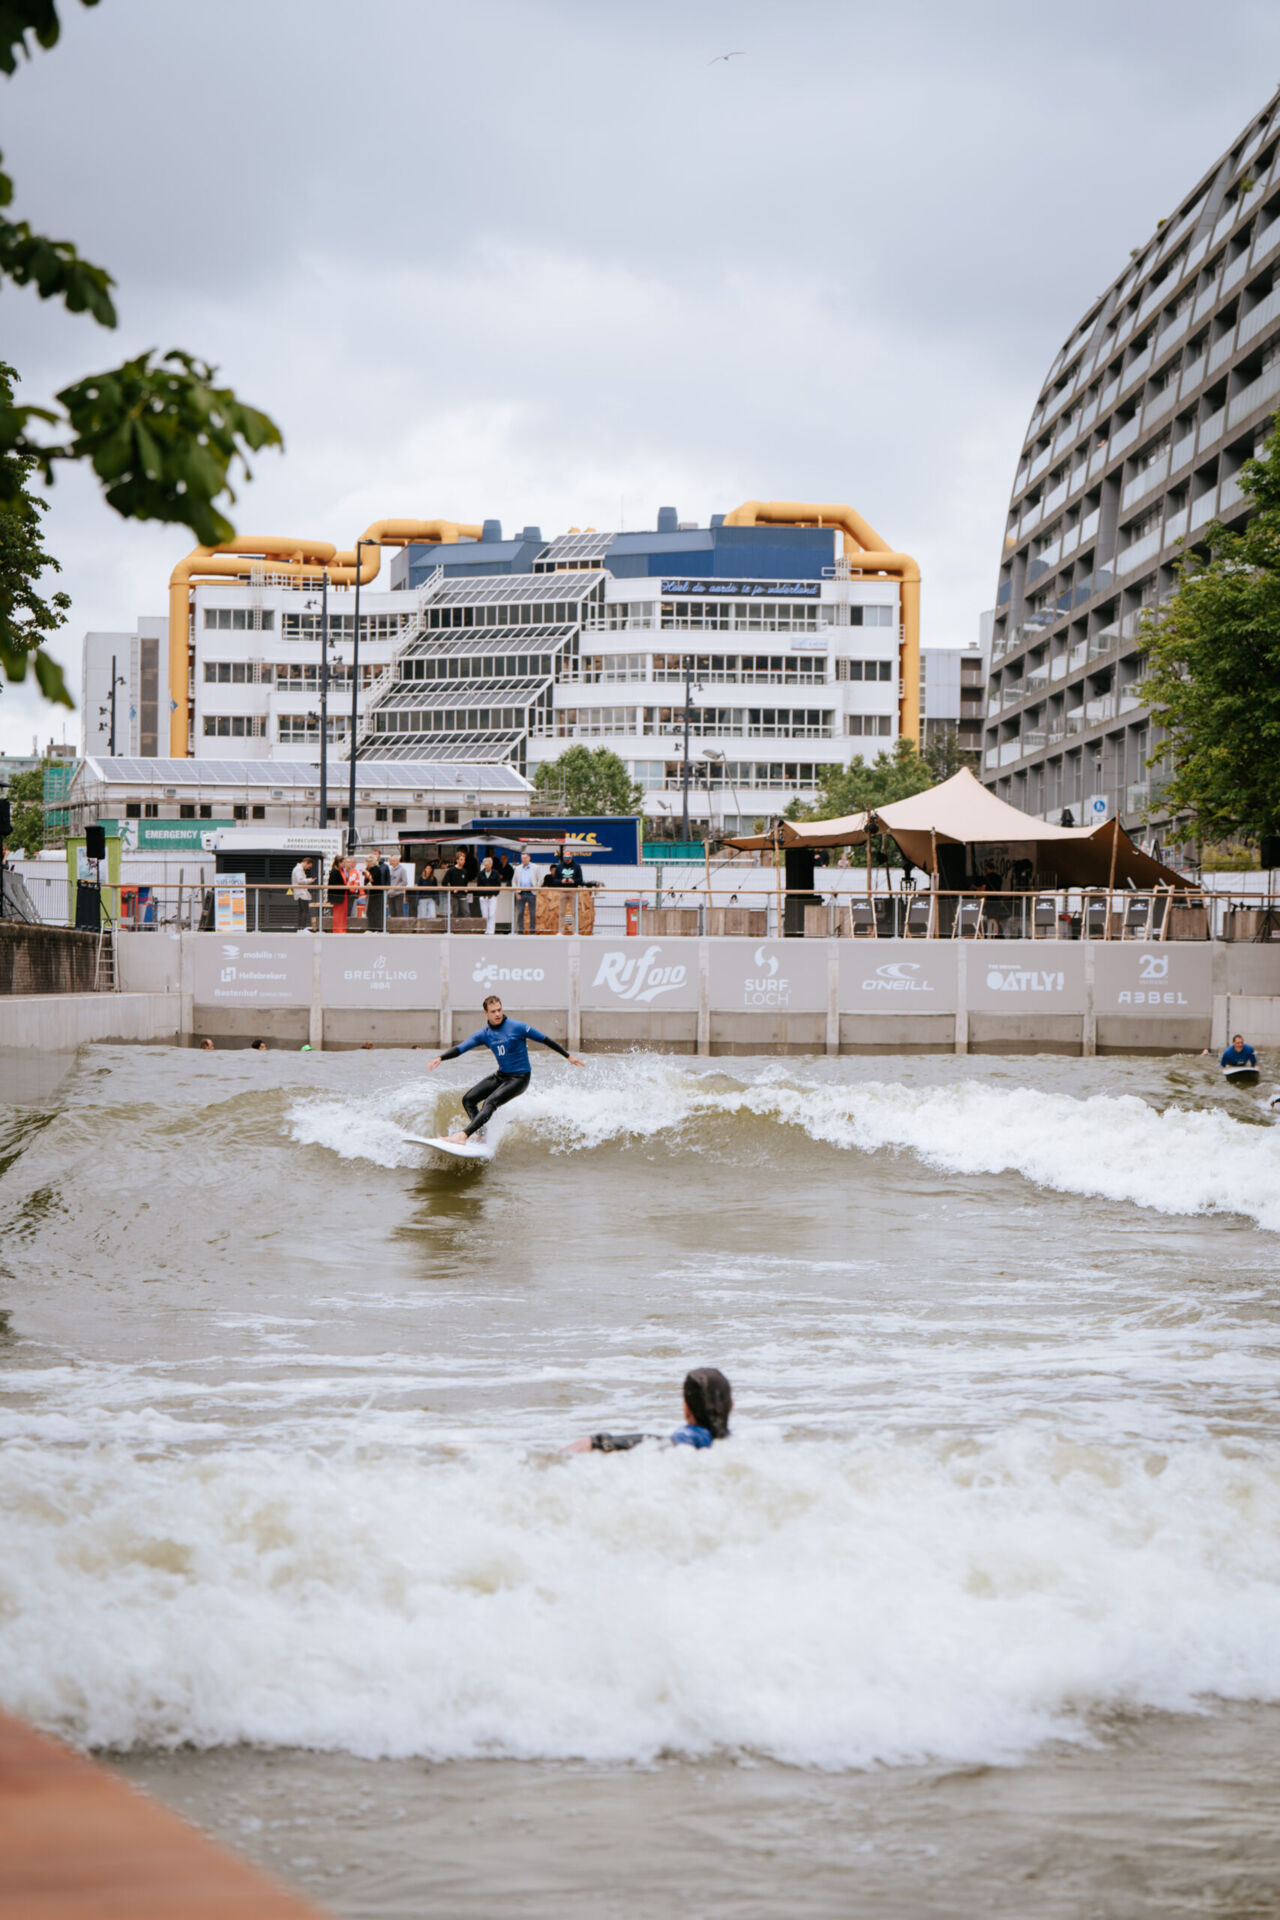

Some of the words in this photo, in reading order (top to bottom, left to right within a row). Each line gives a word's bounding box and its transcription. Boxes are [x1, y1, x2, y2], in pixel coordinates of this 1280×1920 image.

[145, 829, 198, 839] EMERGENCY
[344, 970, 417, 981] BREITLING
[488, 965, 544, 982] Eneco
[744, 979, 789, 991] SURF
[986, 971, 1064, 991] OATLY!
[744, 993, 789, 1006] LOCH
[497, 1044, 506, 1057] 10
